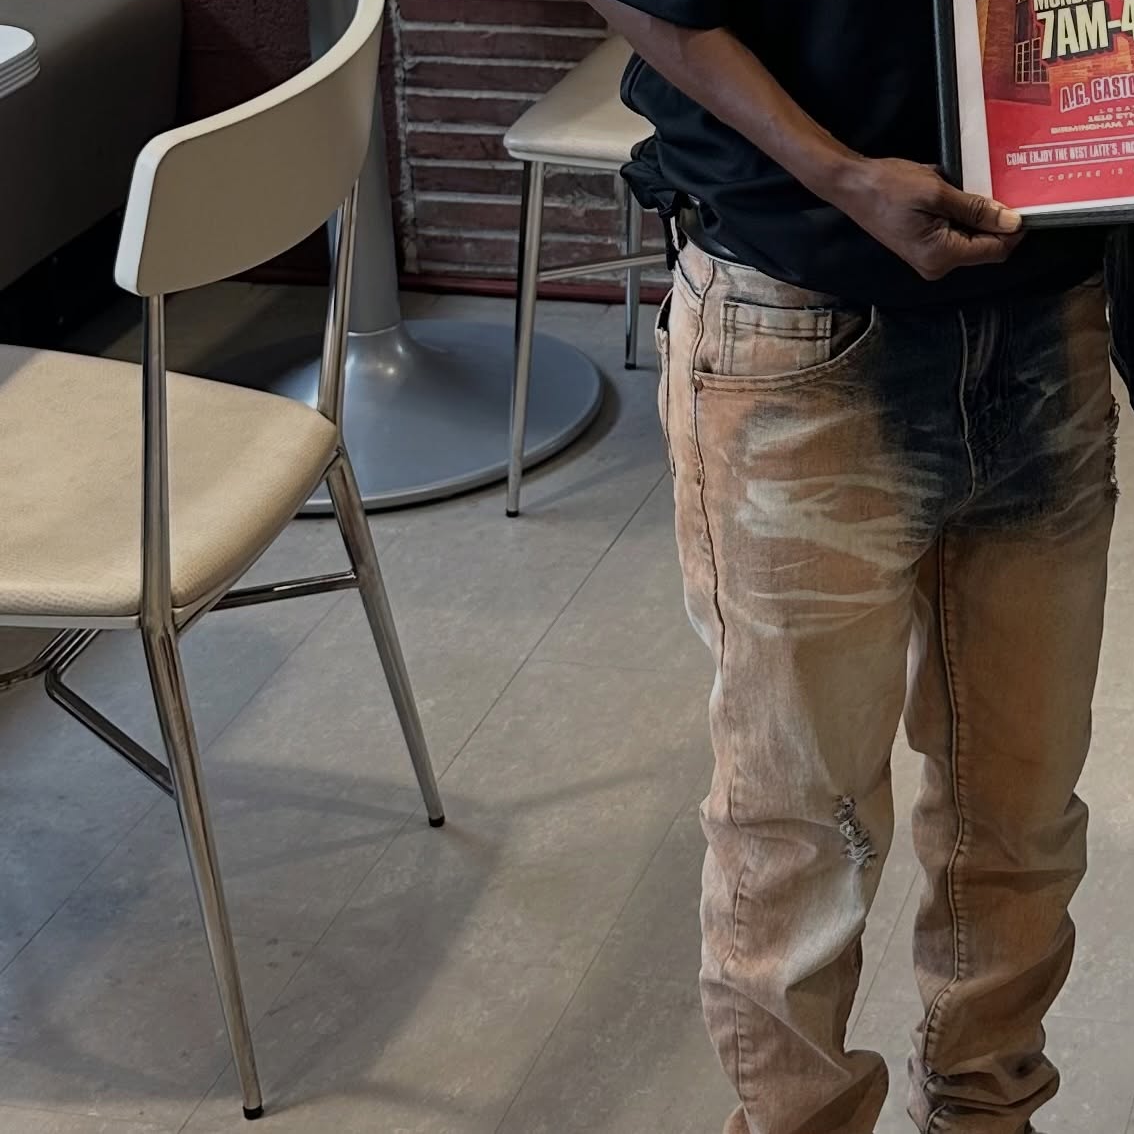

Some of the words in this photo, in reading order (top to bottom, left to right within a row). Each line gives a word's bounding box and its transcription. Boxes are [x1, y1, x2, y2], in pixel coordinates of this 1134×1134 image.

[1060, 82, 1090, 113] A.G.
[1006, 151, 1028, 166] COME
[1029, 149, 1053, 164] ENJOY
[1055, 147, 1068, 161] THE
[1070, 145, 1088, 160] BEST
